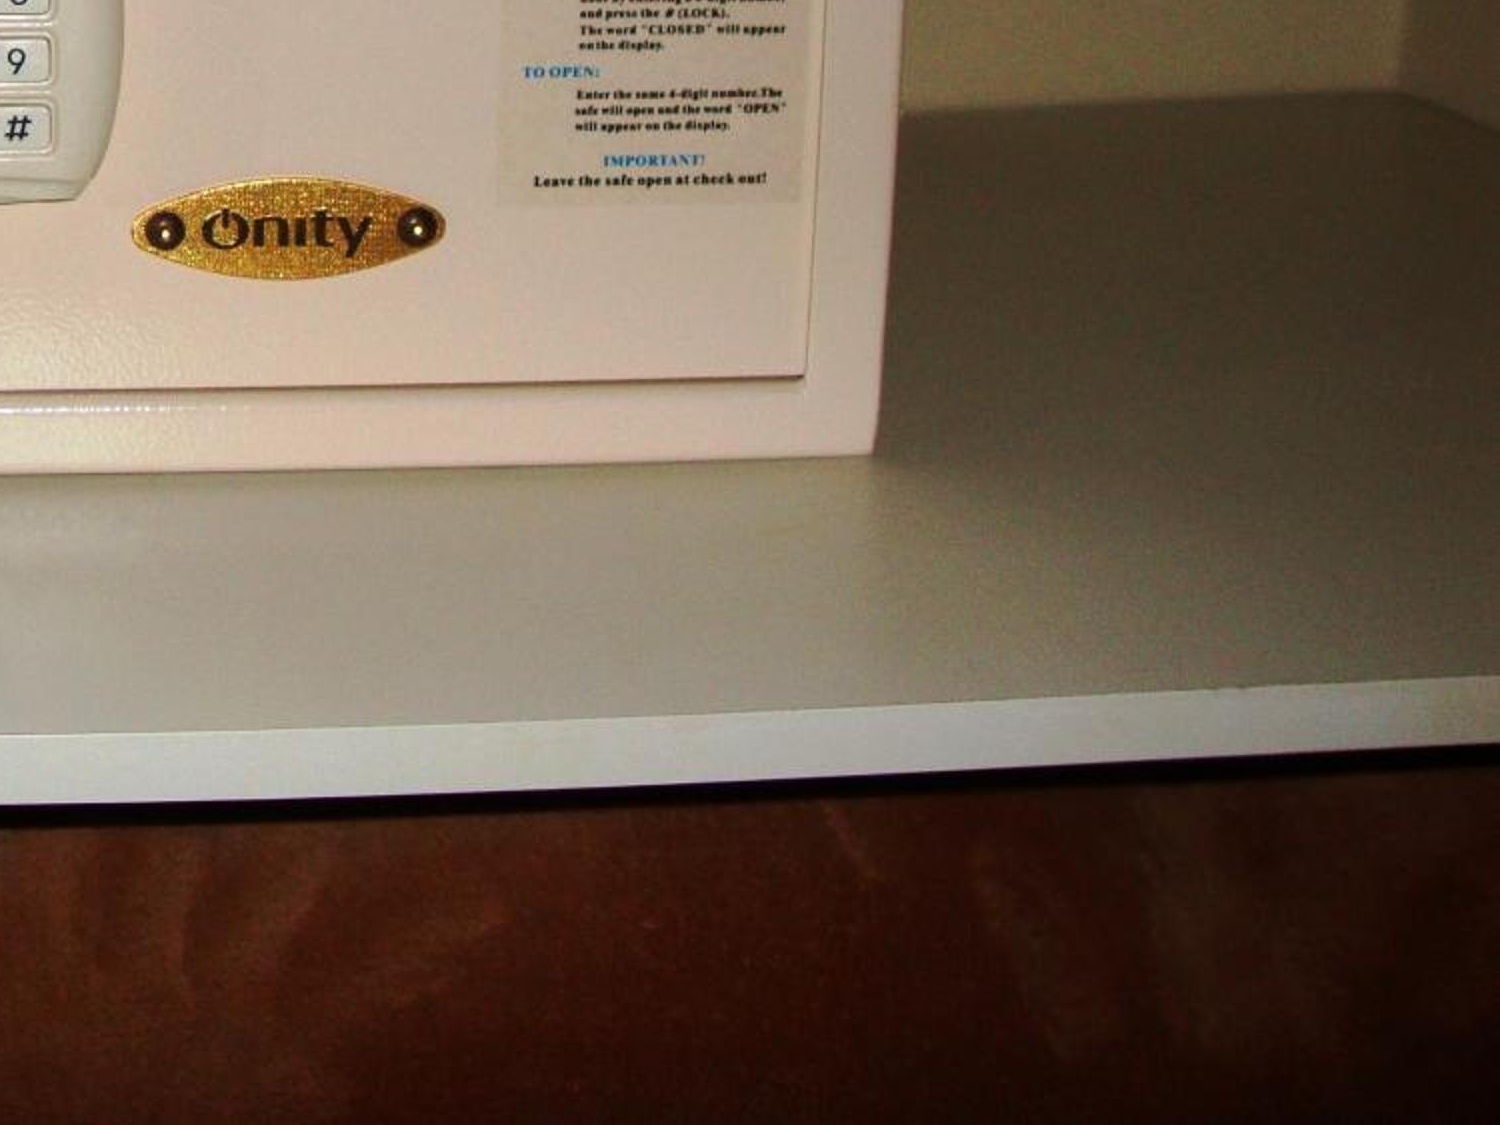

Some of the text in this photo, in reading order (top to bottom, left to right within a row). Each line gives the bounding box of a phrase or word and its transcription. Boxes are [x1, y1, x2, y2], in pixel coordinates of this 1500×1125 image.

[580, 8, 602, 19] and
[605, 10, 638, 21] press
[640, 8, 660, 19] the
[665, 8, 675, 18] #
[580, 25, 602, 35] The
[606, 25, 637, 35] word
[716, 24, 740, 34] will
[743, 25, 786, 37] appear
[579, 40, 664, 52] on the display.
[7, 48, 26, 75] 9
[525, 66, 600, 79] TO OPEN:
[577, 90, 610, 100] Enter
[613, 89, 632, 100] the
[636, 90, 665, 99] same
[669, 88, 709, 101] 4-digit
[575, 105, 599, 116] safe
[601, 105, 623, 115] will
[626, 106, 655, 117] open
[658, 104, 680, 115] and
[683, 104, 701, 114] the
[704, 103, 732, 114] word
[4, 115, 32, 141] #
[575, 120, 730, 135] will appear on the display.
[604, 154, 706, 167] IMPORTANT!
[534, 172, 767, 189] Leave the safe open at check out!
[202, 208, 372, 258] Onity
